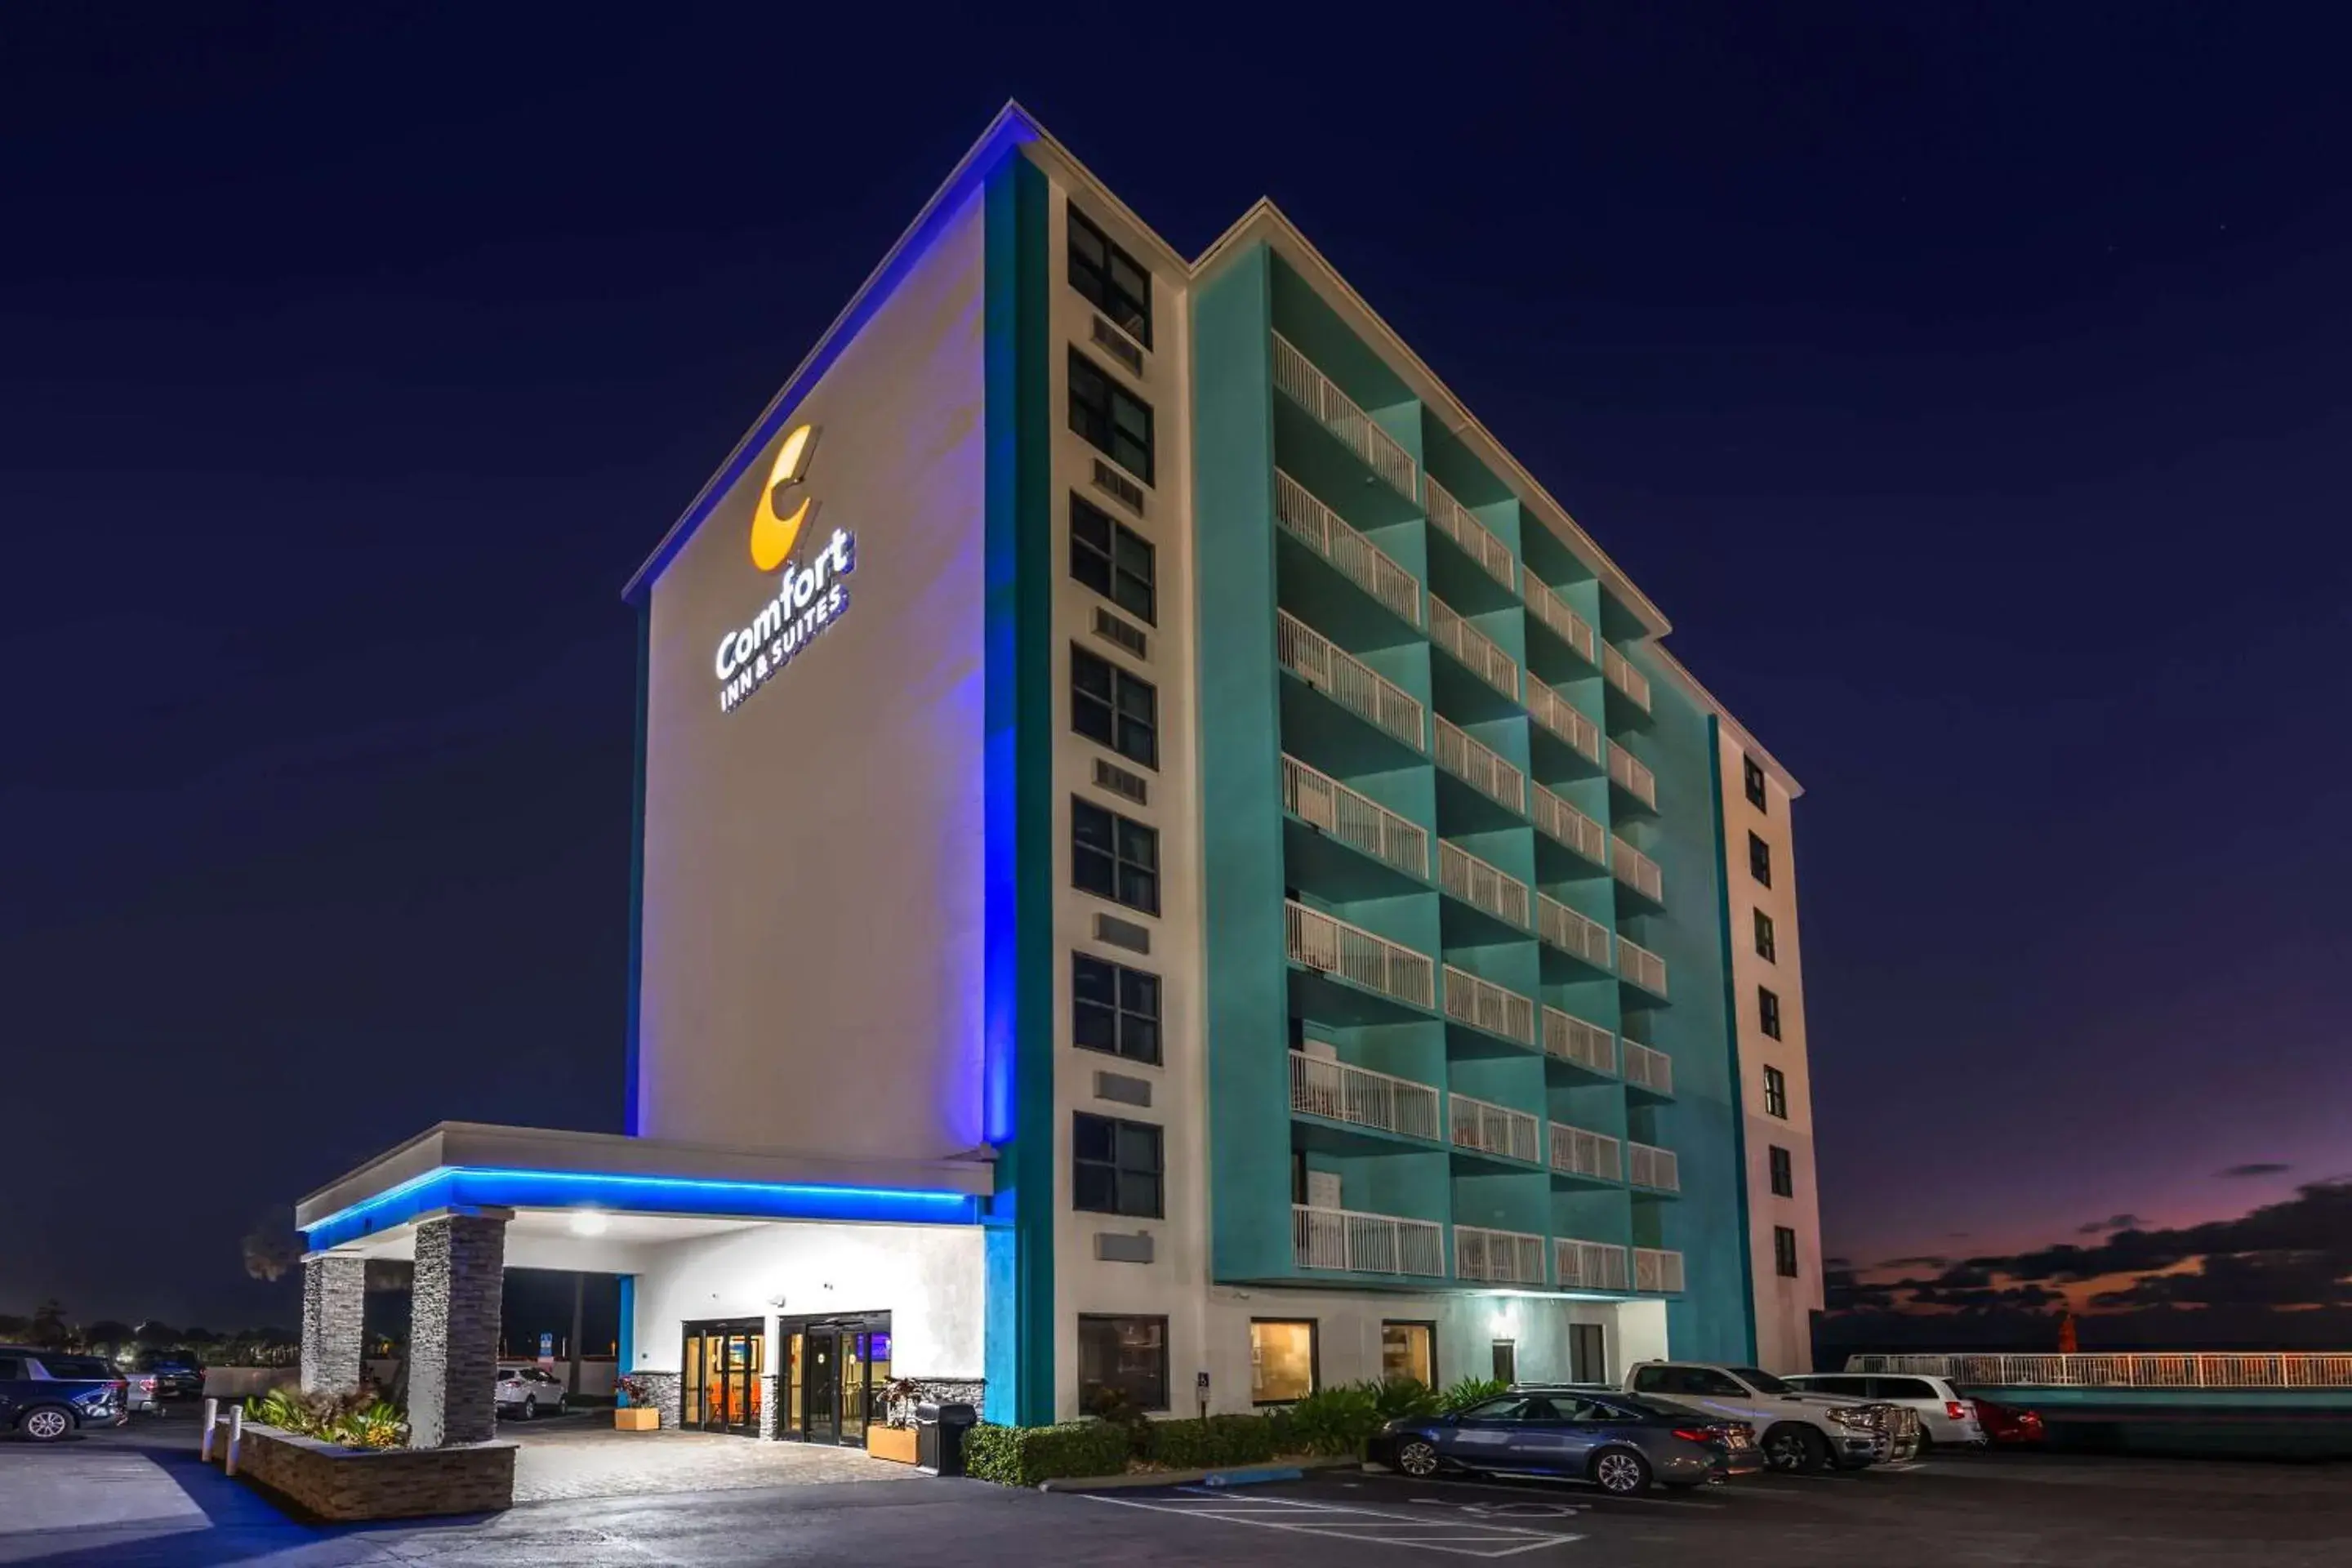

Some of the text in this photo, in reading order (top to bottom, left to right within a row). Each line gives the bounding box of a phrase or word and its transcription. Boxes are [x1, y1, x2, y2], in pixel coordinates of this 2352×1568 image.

[716, 528, 848, 679] Comfort
[721, 584, 841, 712] INN & SUITES
